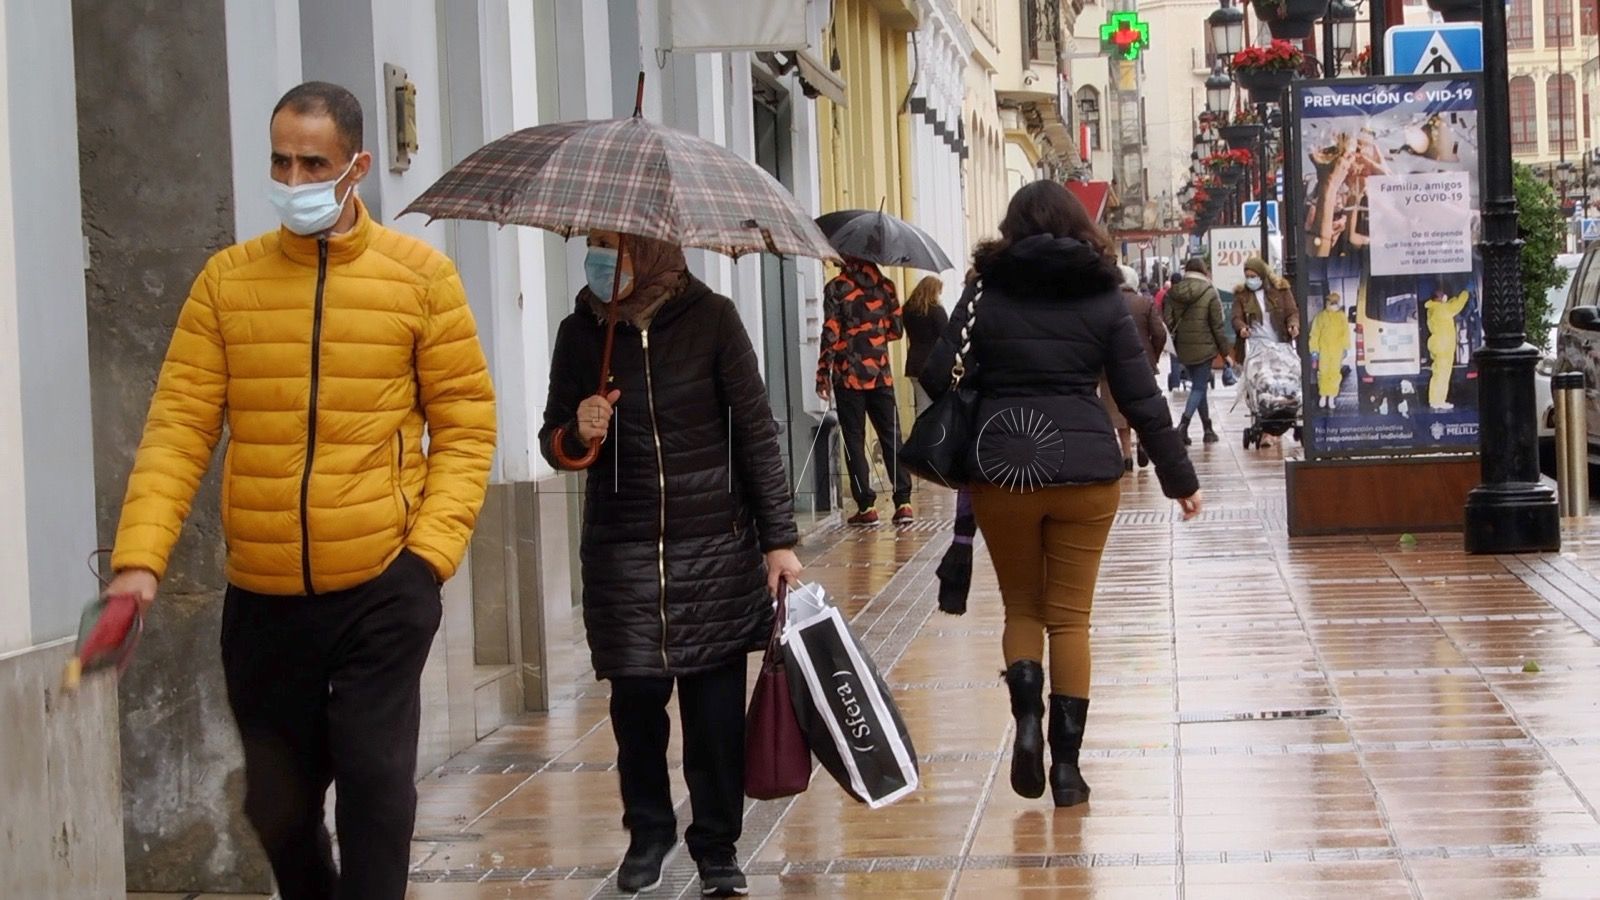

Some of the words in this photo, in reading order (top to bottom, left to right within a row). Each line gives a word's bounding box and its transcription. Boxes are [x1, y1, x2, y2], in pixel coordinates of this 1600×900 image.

[1304, 90, 1400, 107] PREVENCIÓN
[1380, 182, 1422, 192] Familia,
[1424, 181, 1462, 191] amigos
[1405, 196, 1411, 206] y
[1414, 192, 1463, 203] COVID-19
[1218, 240, 1256, 249] HOLA
